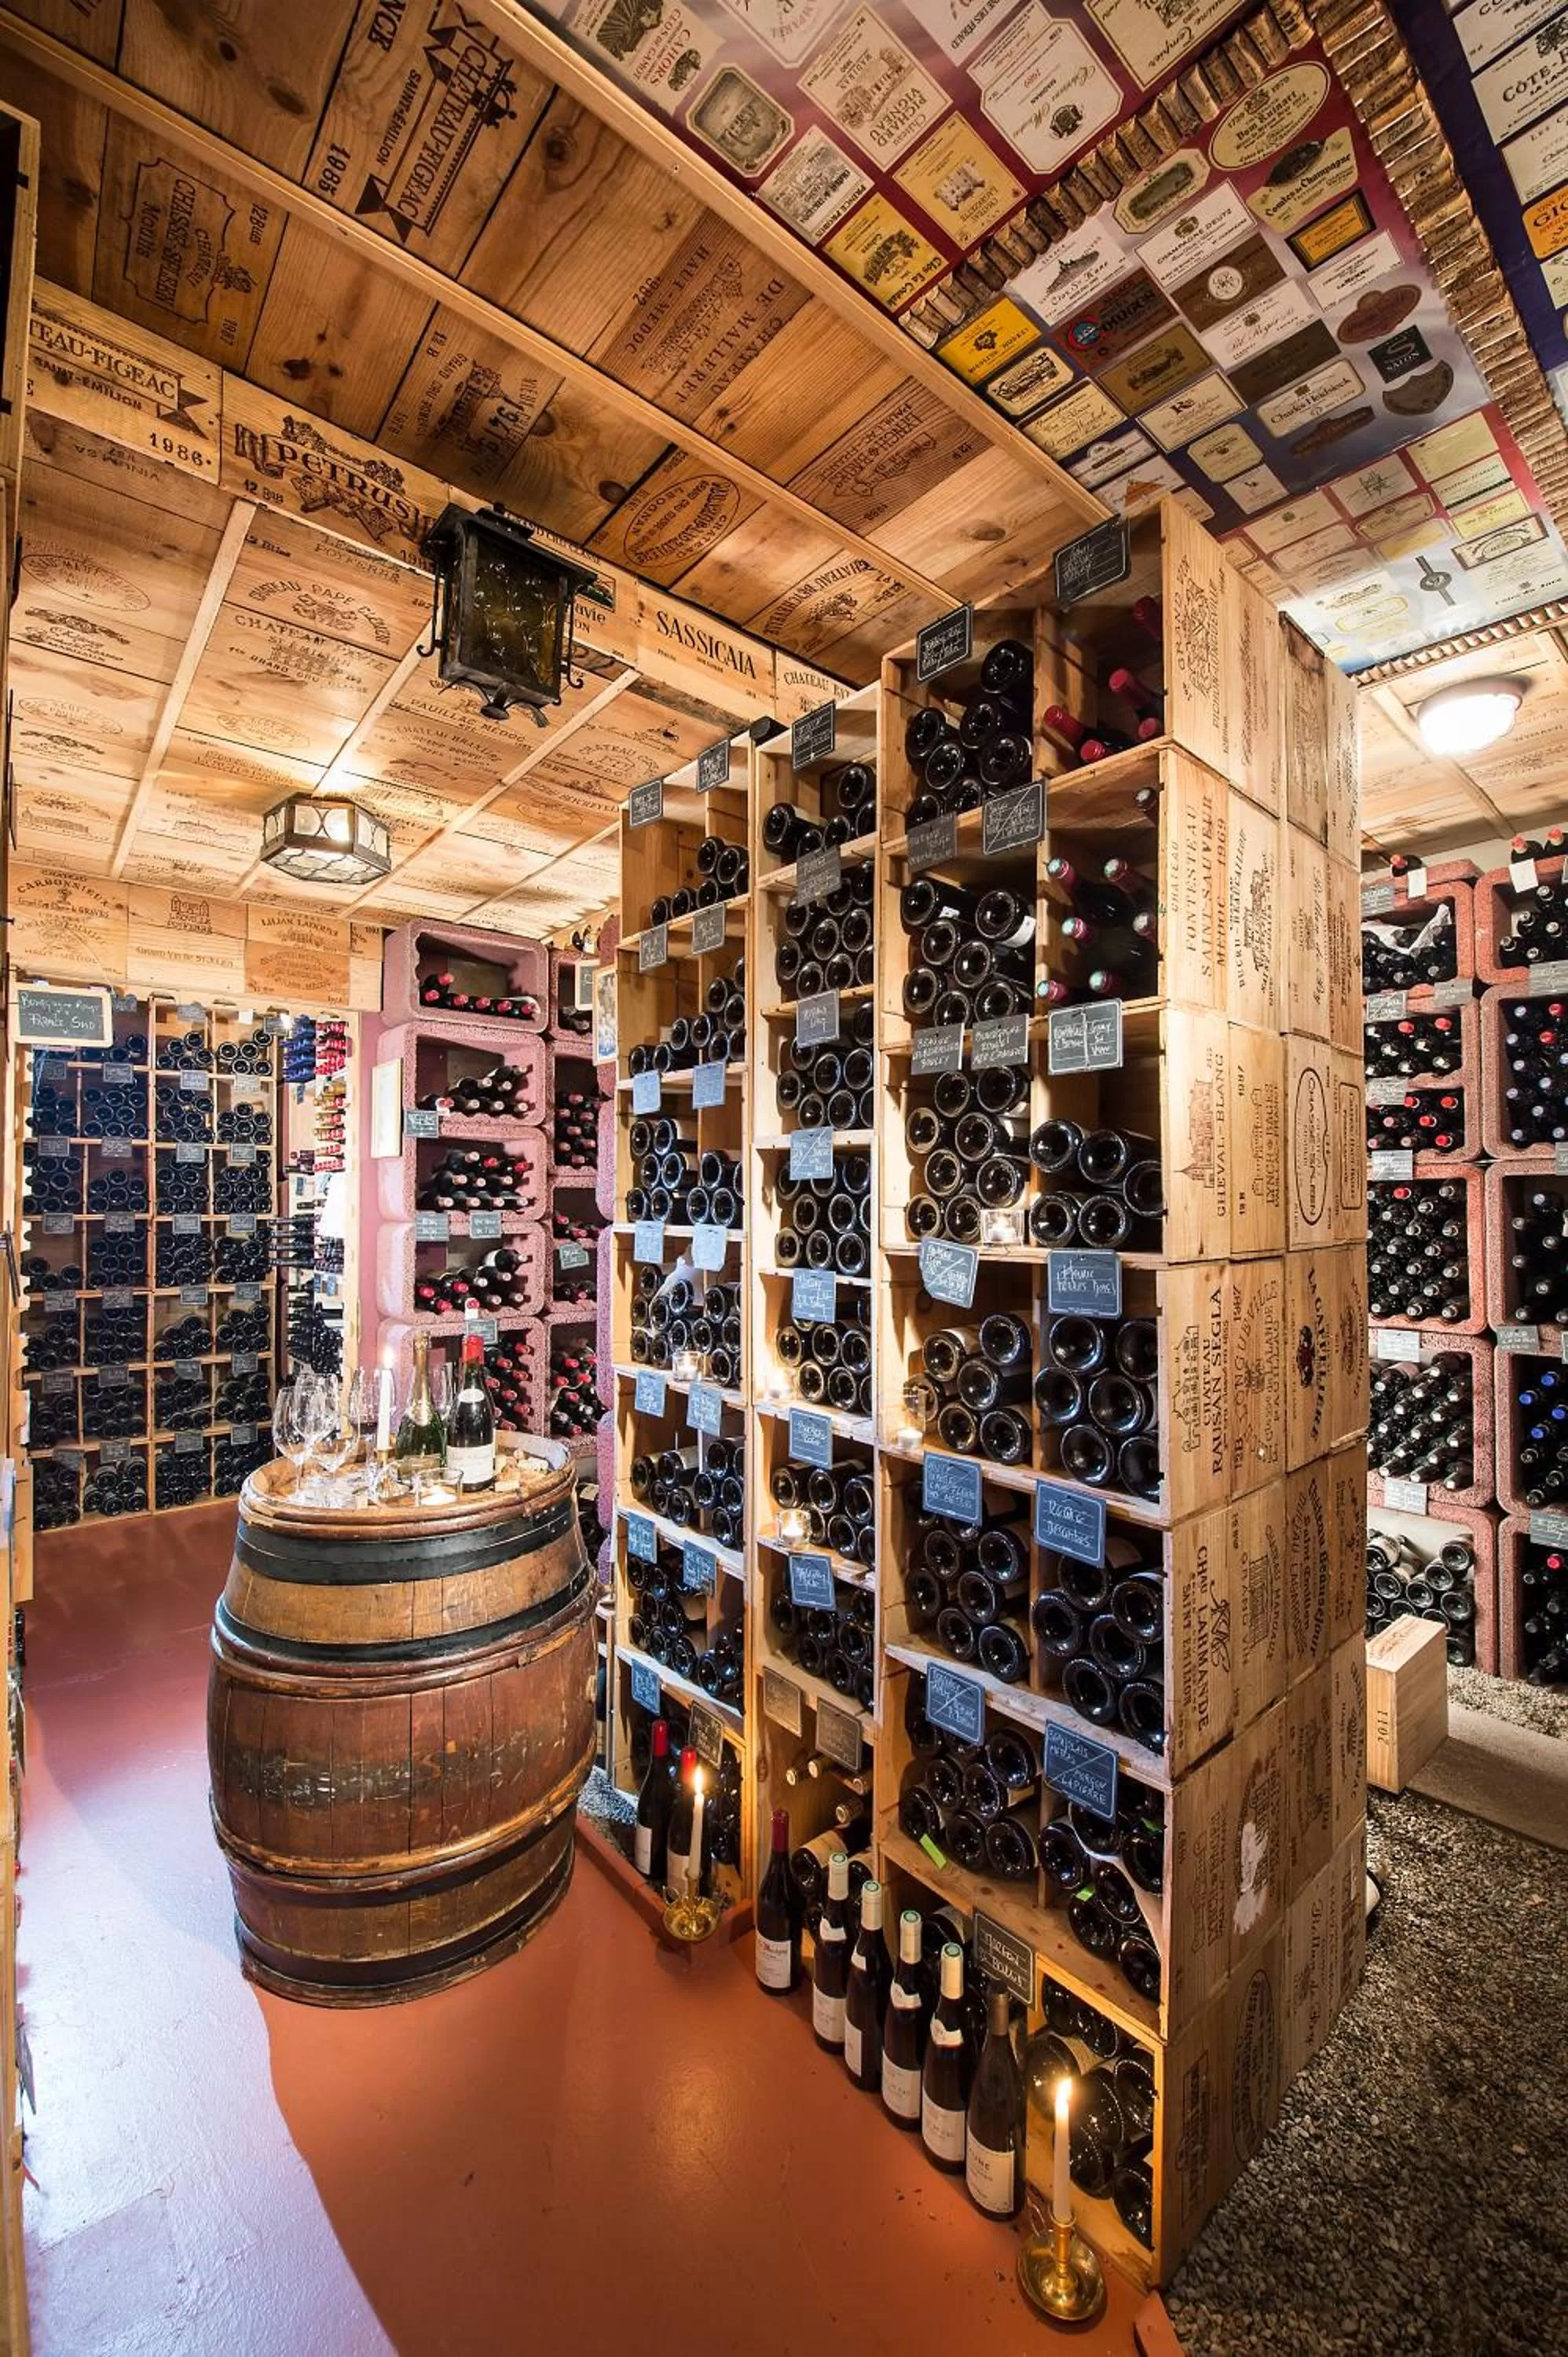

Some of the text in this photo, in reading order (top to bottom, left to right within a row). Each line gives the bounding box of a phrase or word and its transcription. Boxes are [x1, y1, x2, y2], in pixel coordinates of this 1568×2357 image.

[649, 28, 691, 87] CAHORS
[869, 86, 922, 142] VIGNEAU
[877, 92, 929, 149] PICHARD
[1299, 152, 1353, 189] Champagne
[756, 277, 785, 308] DE
[674, 310, 757, 405] MALLERET
[709, 316, 784, 396] CHATEAU
[1385, 350, 1420, 372] SALON
[276, 439, 411, 522] PETRUS
[657, 610, 757, 680] SASSICAIA
[783, 671, 830, 691] CHATEAU
[1185, 804, 1197, 952] FONTESTEAU
[1201, 794, 1213, 977] SAINT-SAUVEUR
[1265, 1305, 1273, 1376] LALANDE
[1210, 1287, 1223, 1474] RAUSAN SEGLA
[1182, 1583, 1192, 1707] SAINT EMILION
[1197, 1605, 1210, 1732] LARMANDE
[1377, 1710, 1389, 1746] 2011
